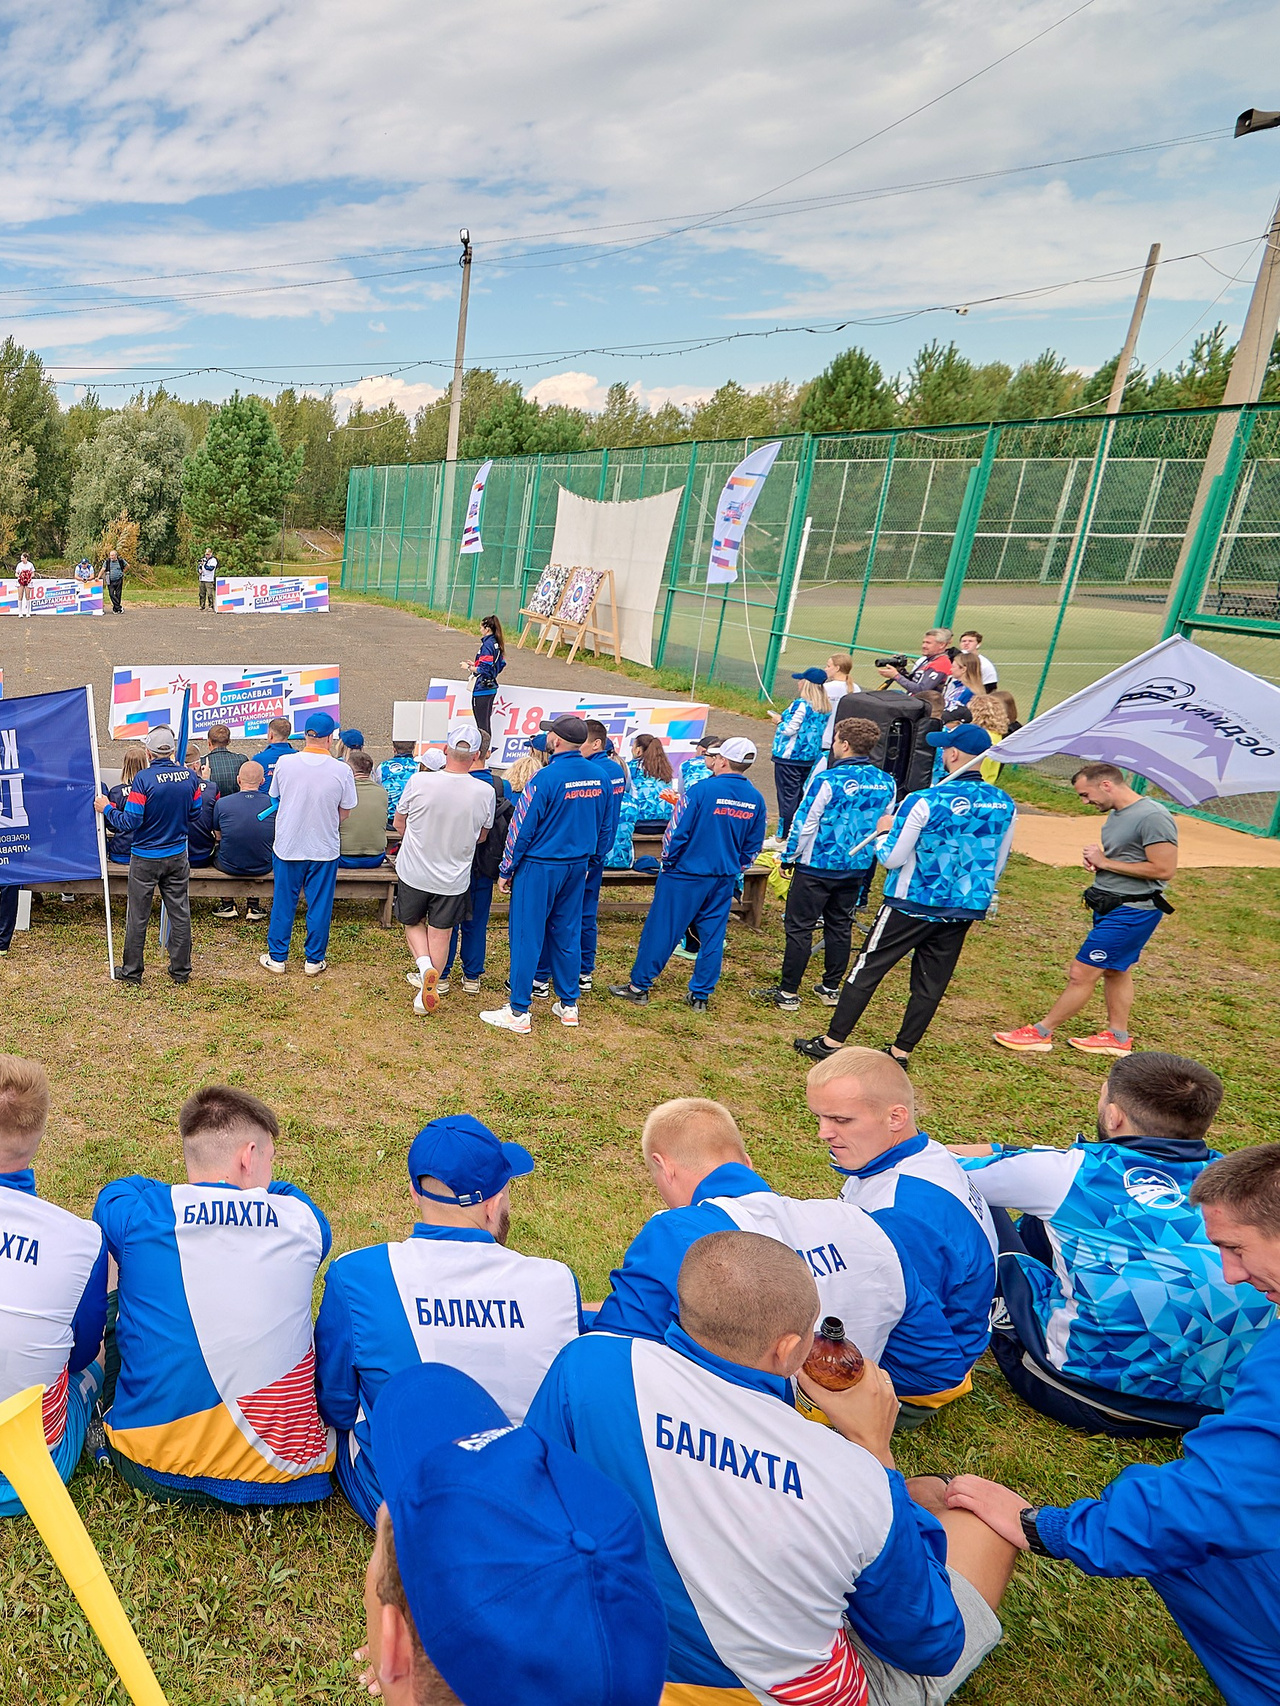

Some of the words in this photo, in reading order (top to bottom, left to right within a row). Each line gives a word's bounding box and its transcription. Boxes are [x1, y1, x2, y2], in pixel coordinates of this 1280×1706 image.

[253, 584, 268, 597] 18
[189, 680, 219, 708] 18
[221, 688, 272, 703] ОТРАСЛЕВАЯ
[194, 699, 283, 722] СПАРТАКИАДА
[504, 706, 543, 735] 18
[1172, 701, 1276, 757] КРАЙДЭО
[156, 771, 190, 783] КРУДОР
[564, 788, 602, 800] АВТОДОР
[713, 807, 754, 820] АВТОДОР
[183, 1200, 279, 1228] БАЛАХТА
[415, 1297, 525, 1329] БАЛАХТА
[656, 1413, 804, 1500] БАЛАХТА
